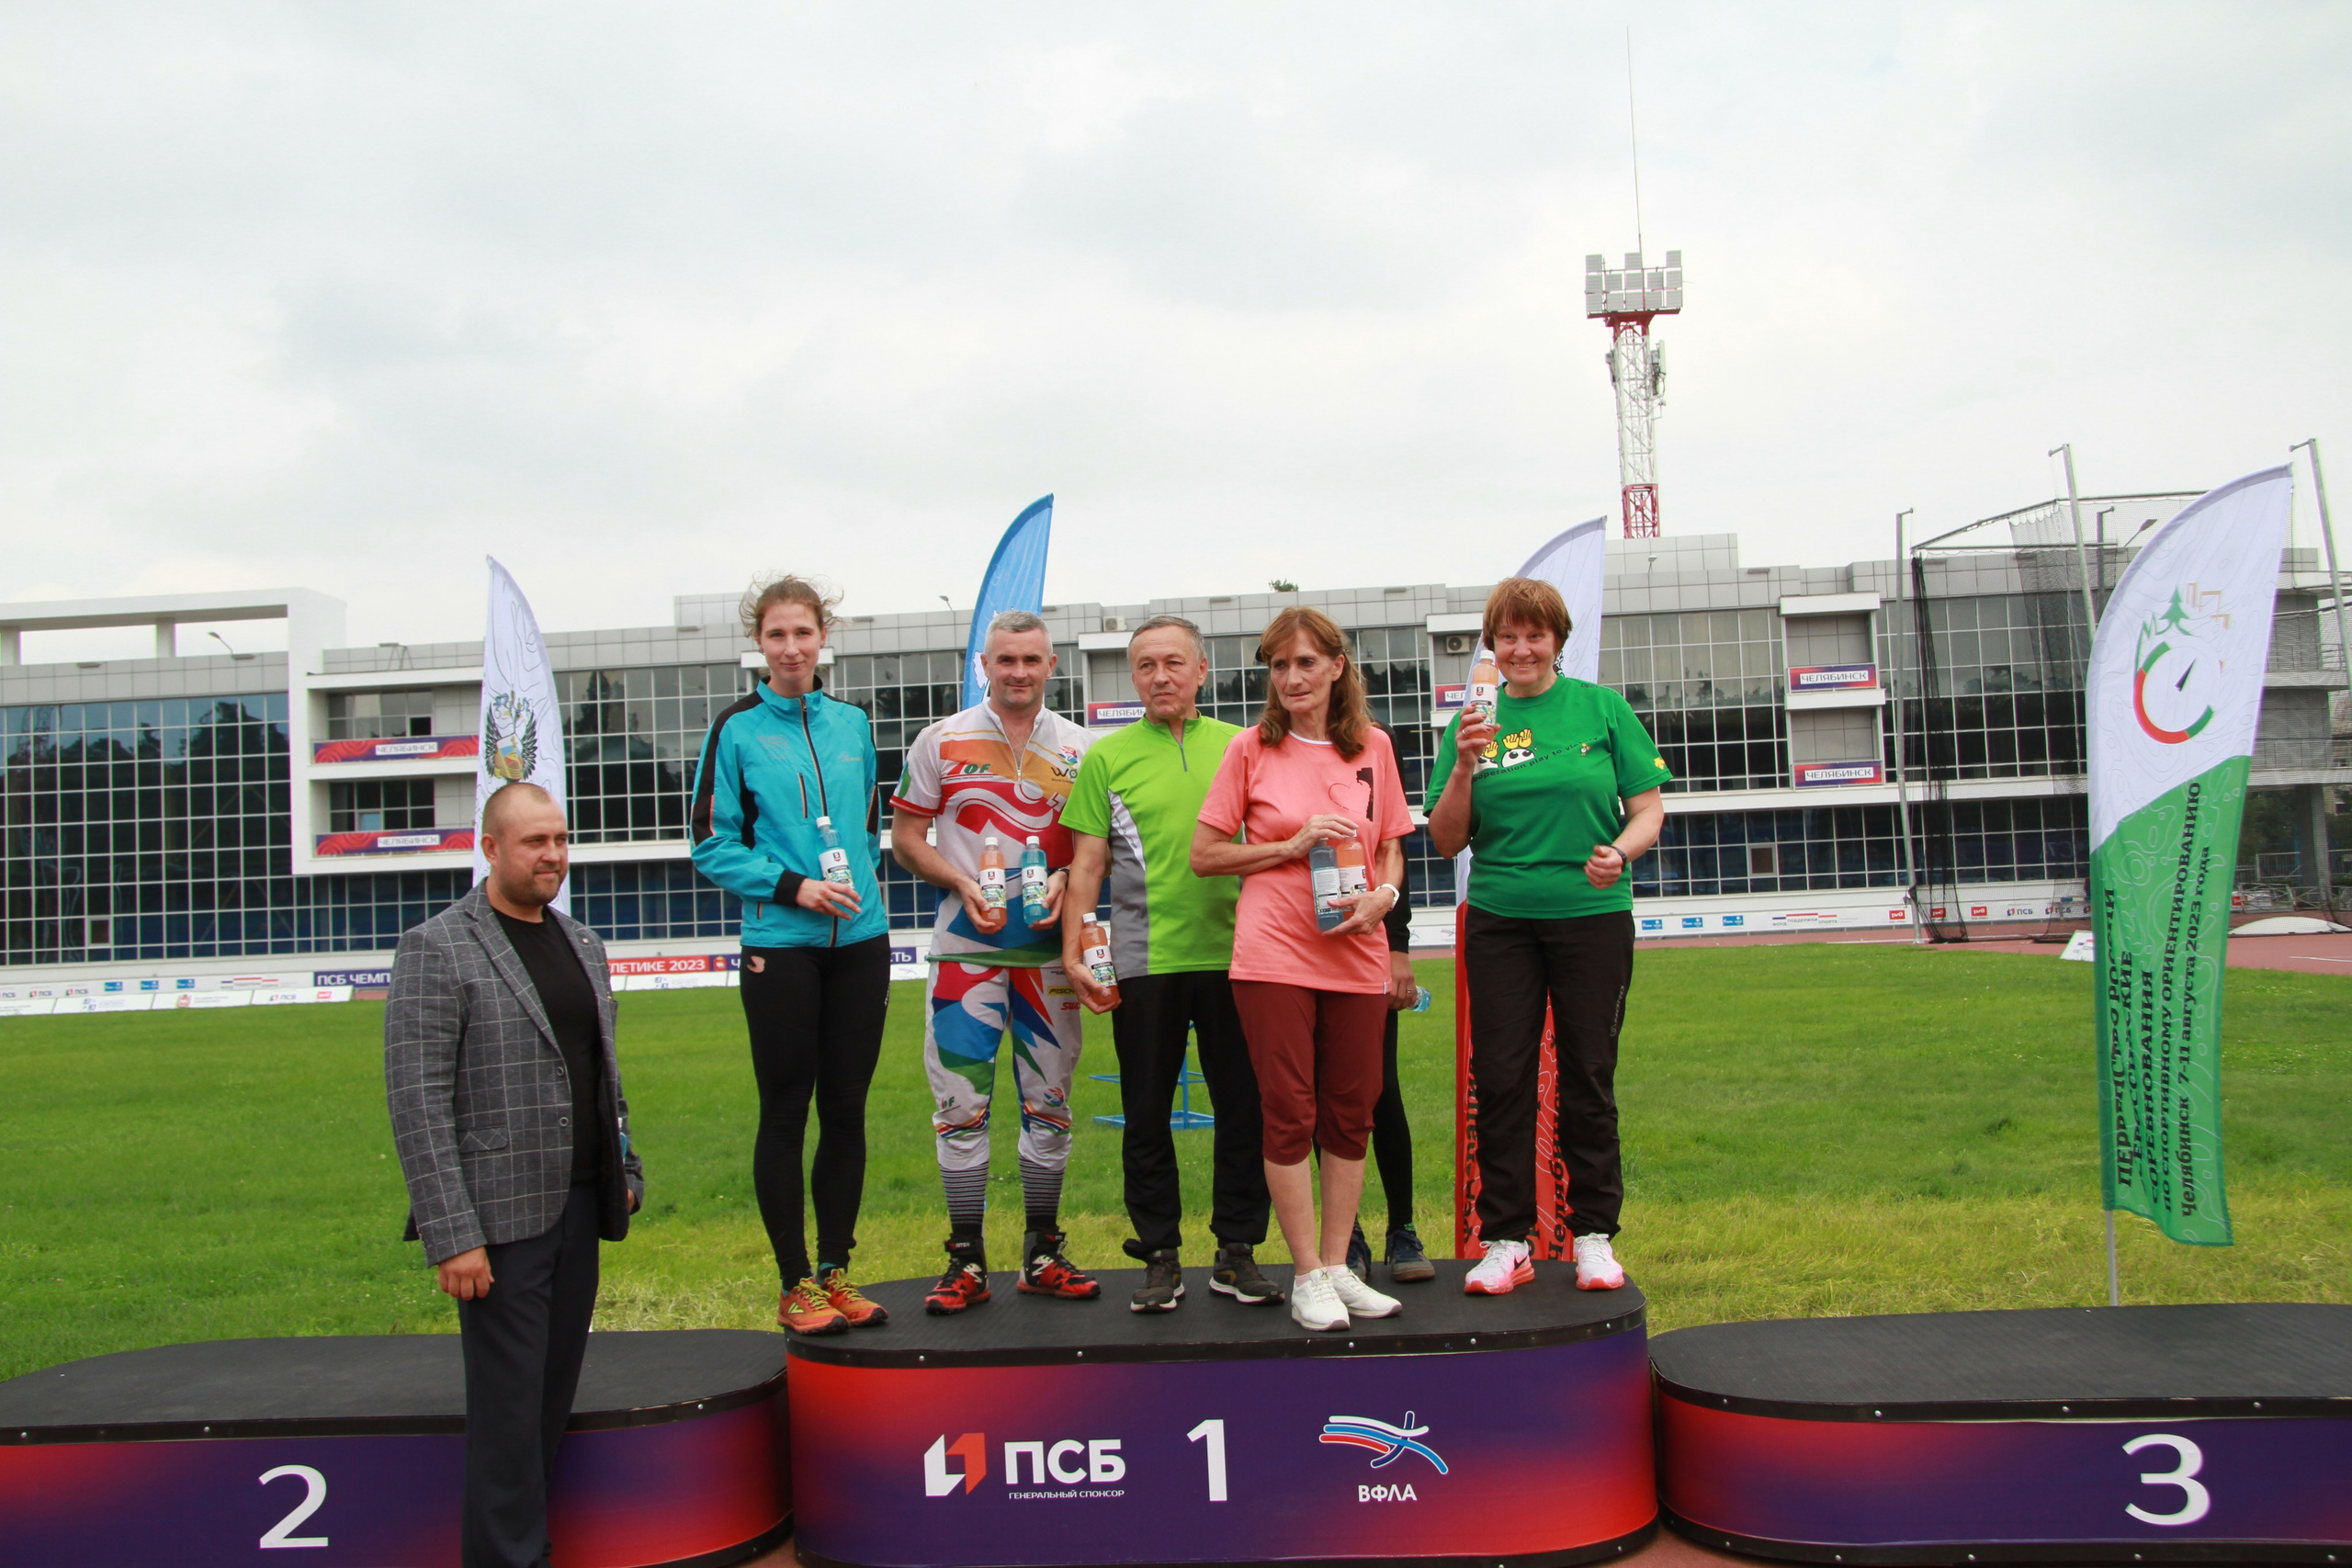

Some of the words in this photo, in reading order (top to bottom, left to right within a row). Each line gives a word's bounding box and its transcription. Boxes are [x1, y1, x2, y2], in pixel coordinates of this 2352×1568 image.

[1801, 671, 1867, 682] ЧЕЛЯБИНСК
[1098, 708, 1146, 717] ЧЕЛЯБИН
[377, 744, 436, 754] ЧЕЛЯБИНСК
[1529, 754, 1550, 766] play
[1806, 768, 1872, 779] ЧЕЛЯБИНСК
[379, 836, 438, 846] ЧЕЛЯБИНСК
[2195, 846, 2211, 897] года
[2161, 783, 2200, 1002] ОРИЕНТИРОВАНИЮ
[2186, 900, 2201, 952] 2023
[609, 961, 665, 974] ЛЕТИКЕ
[669, 959, 706, 972] 2023
[890, 952, 912, 963] ТЬ
[317, 975, 347, 986] ПСБ
[349, 973, 391, 984] ЧЕМП
[2181, 956, 2197, 1042] августа
[2177, 1045, 2190, 1085] 7-11
[2141, 970, 2160, 1204] СОРЕВНОВАНИЯ
[2160, 1005, 2172, 1176] СПОРТИВНОМУ
[2176, 1096, 2197, 1217] Челябинск
[2161, 1179, 2171, 1213] ПО
[1004, 1438, 1125, 1484] ПСБ
[1186, 1418, 1227, 1501] 1
[1009, 1489, 1077, 1499] ГЕНЕРАЛЬНЫЙ
[1079, 1490, 1125, 1498] СПОНСОР
[1358, 1483, 1418, 1503] ВФЛА
[2121, 1433, 2211, 1526] 3
[258, 1464, 329, 1549] 2
